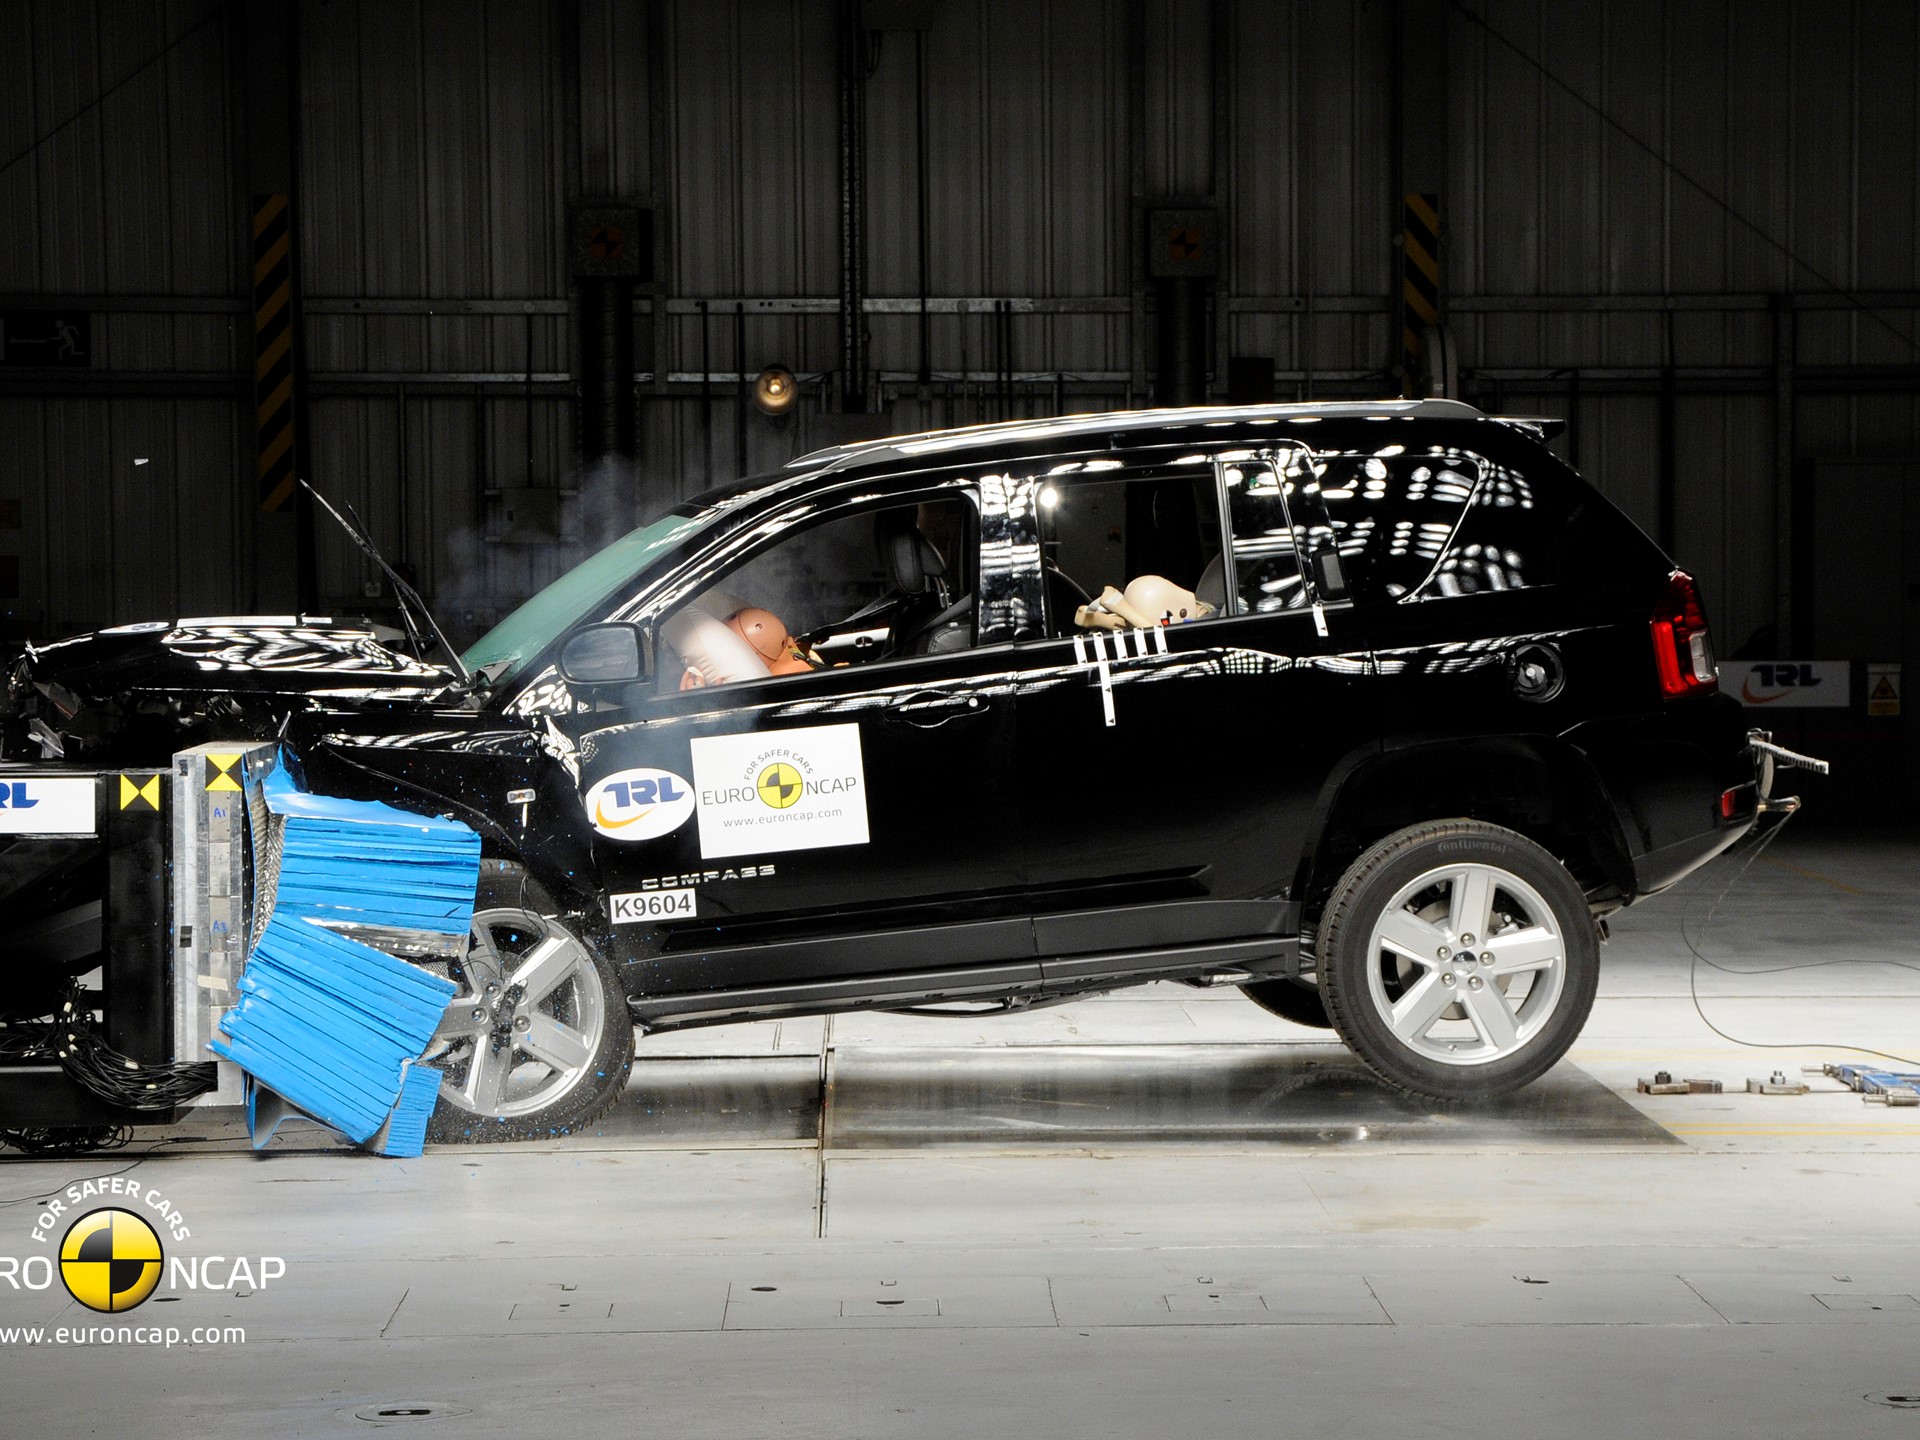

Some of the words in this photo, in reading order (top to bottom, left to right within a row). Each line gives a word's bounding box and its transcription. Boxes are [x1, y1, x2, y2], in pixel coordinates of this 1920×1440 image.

[1751, 664, 1822, 687] TRL
[744, 761, 758, 780] FOR
[758, 749, 790, 762] SAFER
[792, 753, 814, 775] CARS
[603, 777, 686, 808] TRL
[702, 787, 755, 806] EURO
[806, 777, 857, 795] NCAP
[723, 808, 842, 827] www.euroncap.com
[641, 864, 776, 890] COMPASS
[614, 893, 692, 919] K9604
